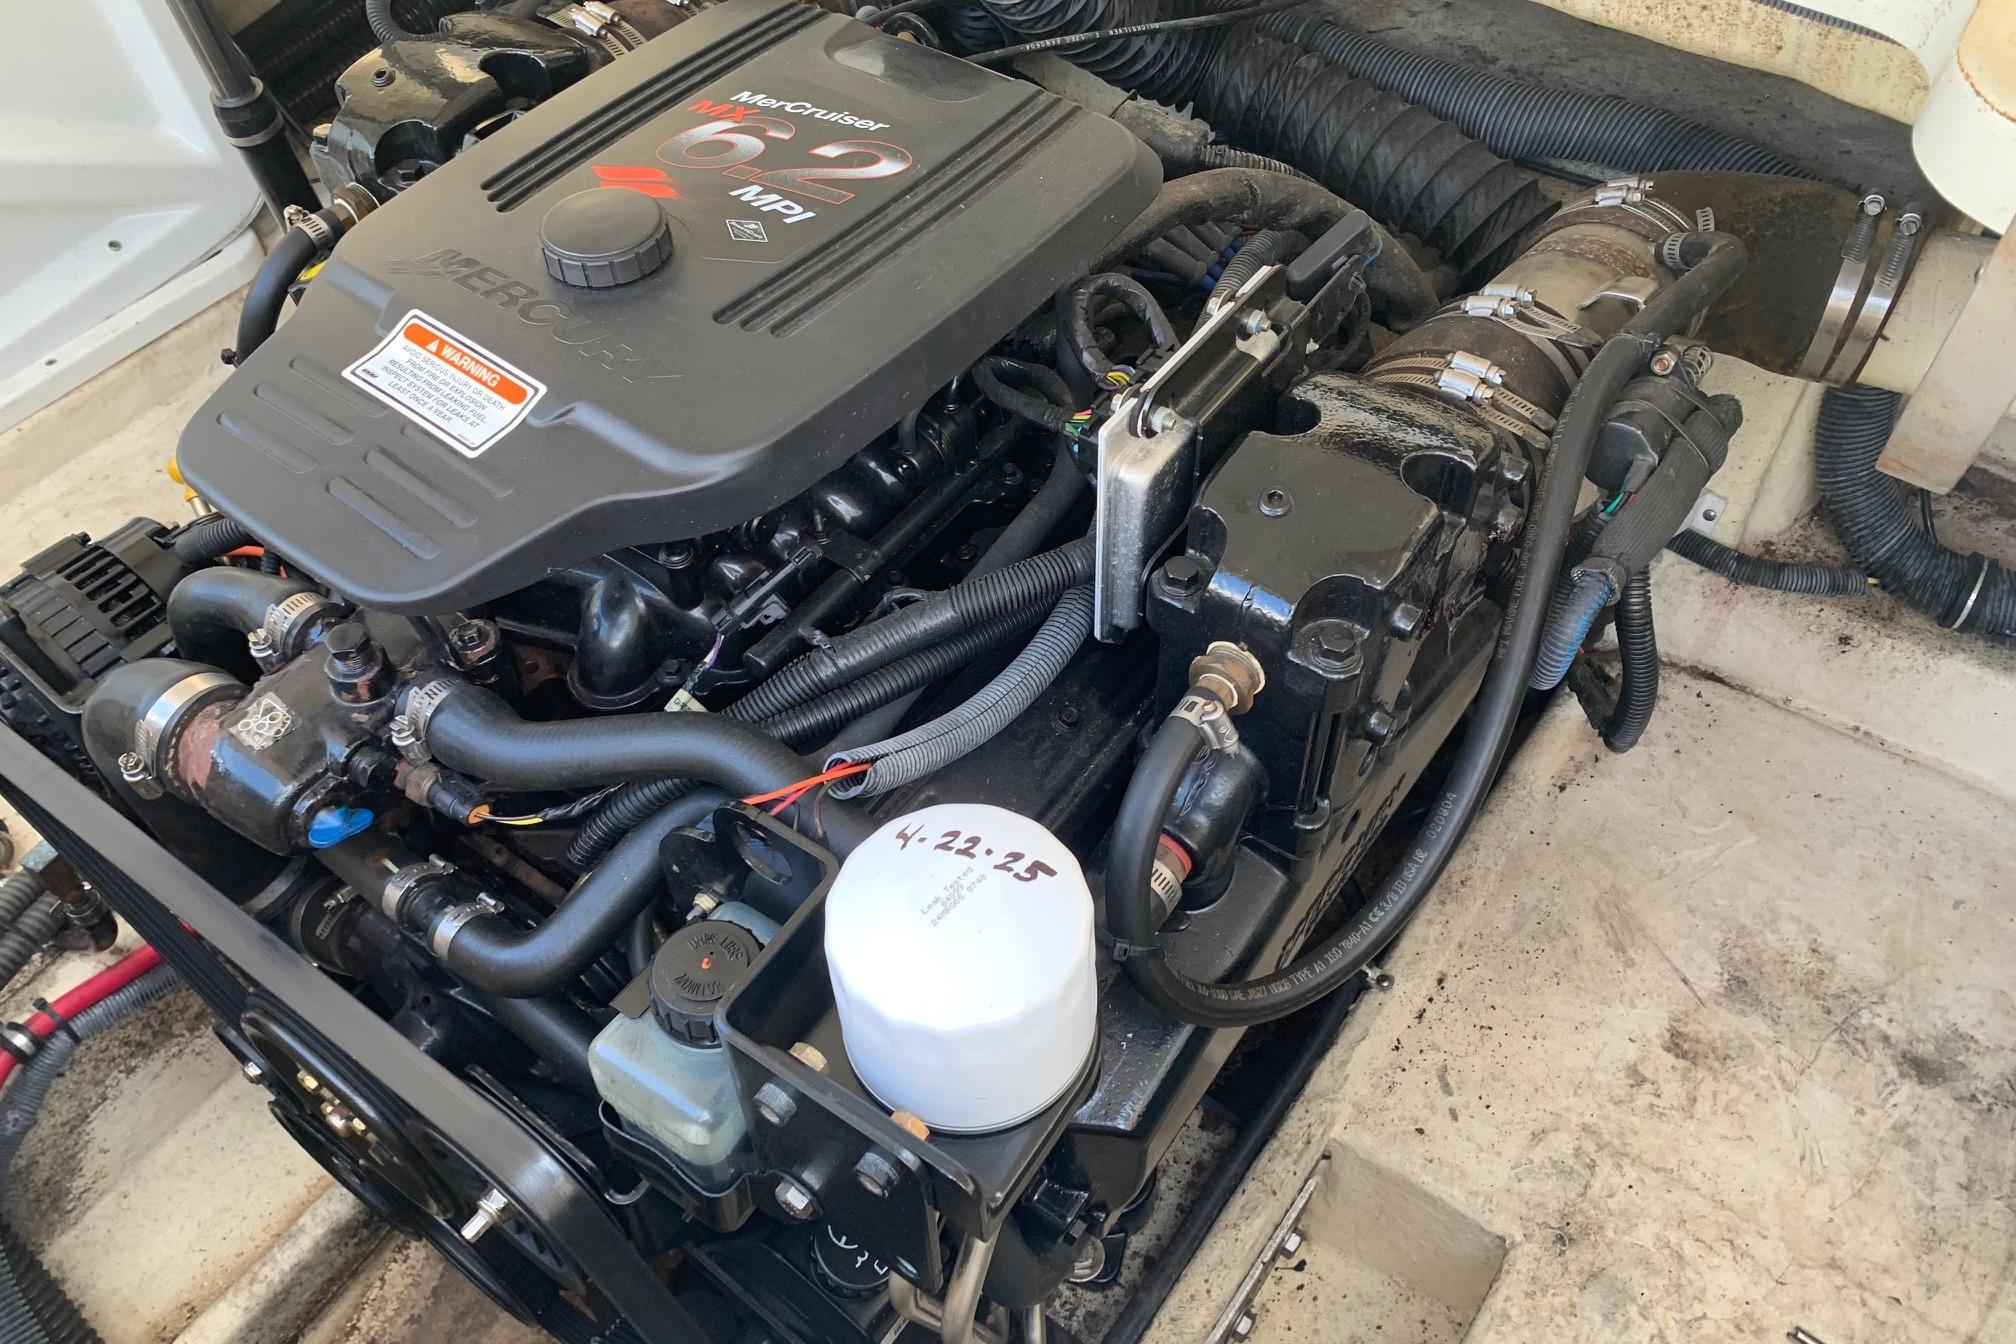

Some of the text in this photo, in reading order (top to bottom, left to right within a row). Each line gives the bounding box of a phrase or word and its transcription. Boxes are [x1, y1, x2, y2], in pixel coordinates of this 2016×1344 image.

[687, 99, 761, 123] MX
[730, 91, 890, 132] MerCruiser
[656, 116, 913, 205] 6.2
[729, 184, 816, 224] MPI
[416, 248, 685, 384] MERCURY
[387, 359, 423, 382] RESULTING
[420, 379, 442, 393] FROM
[439, 390, 470, 410] LEAKING
[402, 344, 505, 411] AVOID SERIOUS INJURY OR DEATH
[405, 358, 488, 410] FROM FIRE OR EXPLOSION
[441, 343, 501, 388] WARNING
[380, 365, 409, 383] INSPECT
[406, 381, 434, 399] SYSTEM
[431, 396, 448, 408] FOR
[446, 406, 470, 422] LEAKS
[468, 419, 480, 428] AT
[387, 380, 410, 395] LEAST
[408, 393, 429, 407] ONCE
[920, 865, 973, 915] Leak Tested
[1289, 967, 1314, 985] TYPE
[1313, 959, 1326, 974] A1
